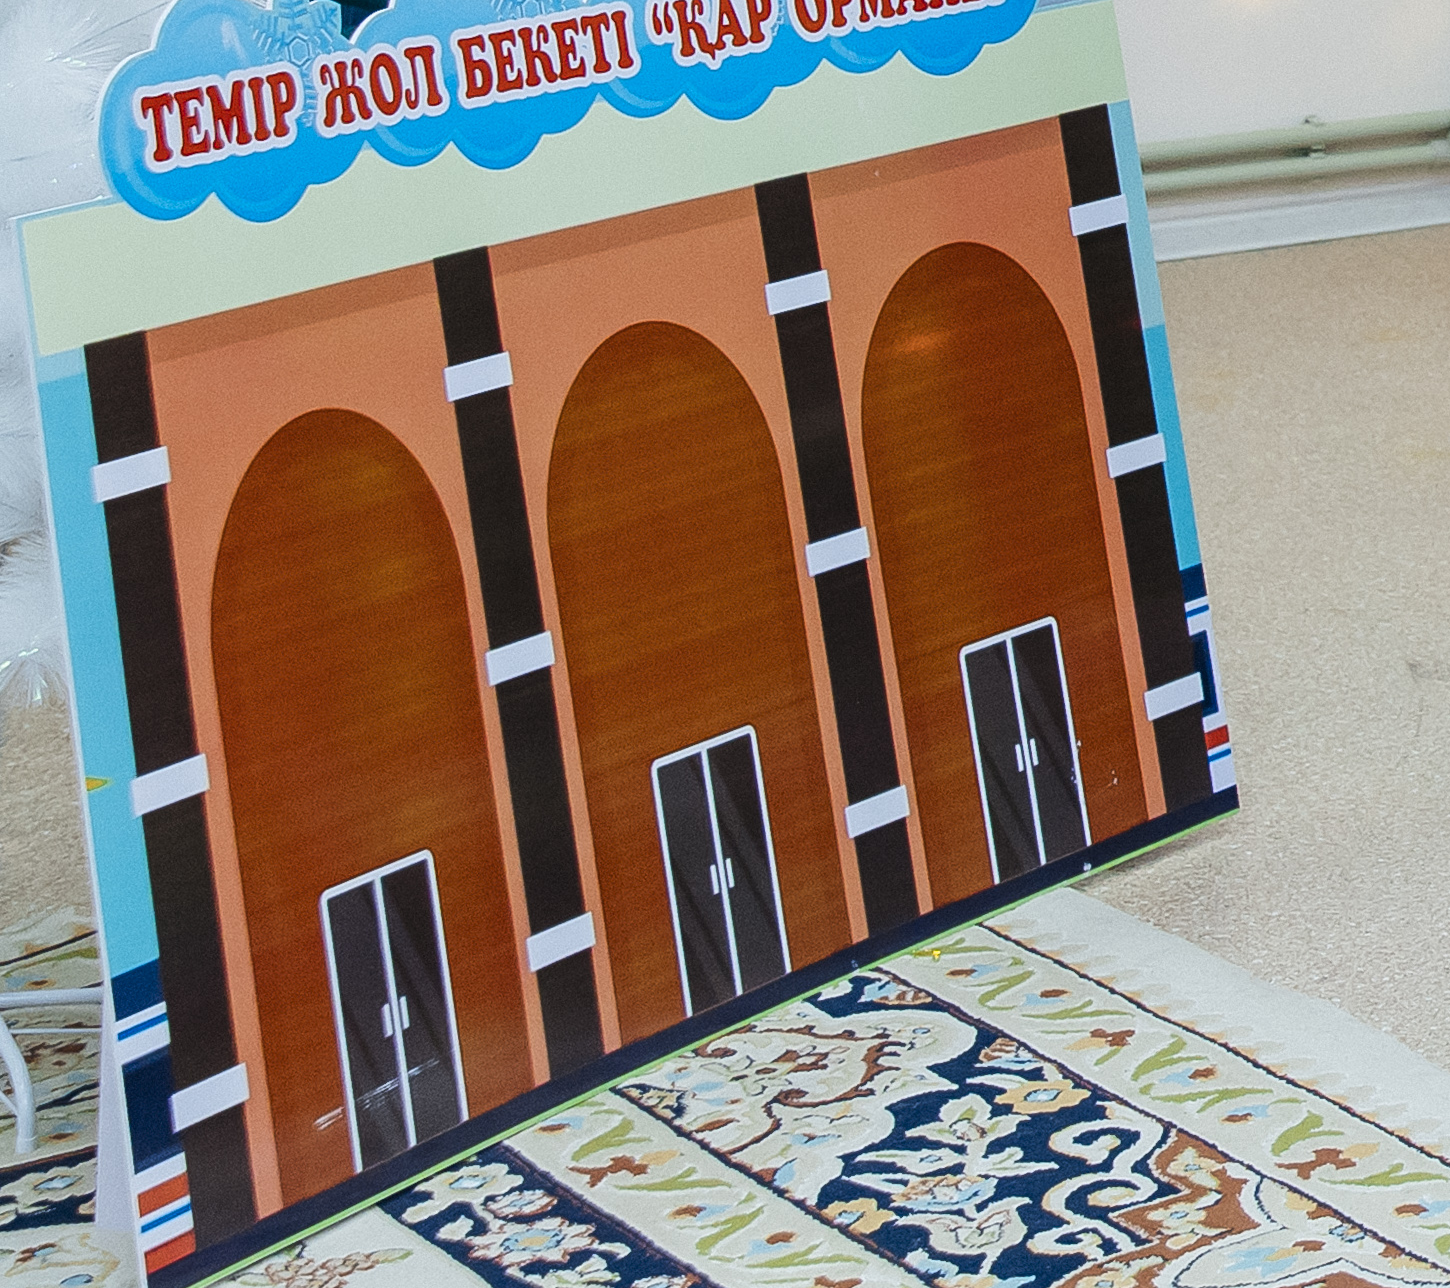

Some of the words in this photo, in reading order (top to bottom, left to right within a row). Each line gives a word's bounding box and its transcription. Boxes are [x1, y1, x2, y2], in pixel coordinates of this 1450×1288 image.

[141, 71, 297, 162] ТЕМІР
[320, 46, 443, 128] ЖОЛ
[457, 9, 634, 99] БЕКЕТІ
